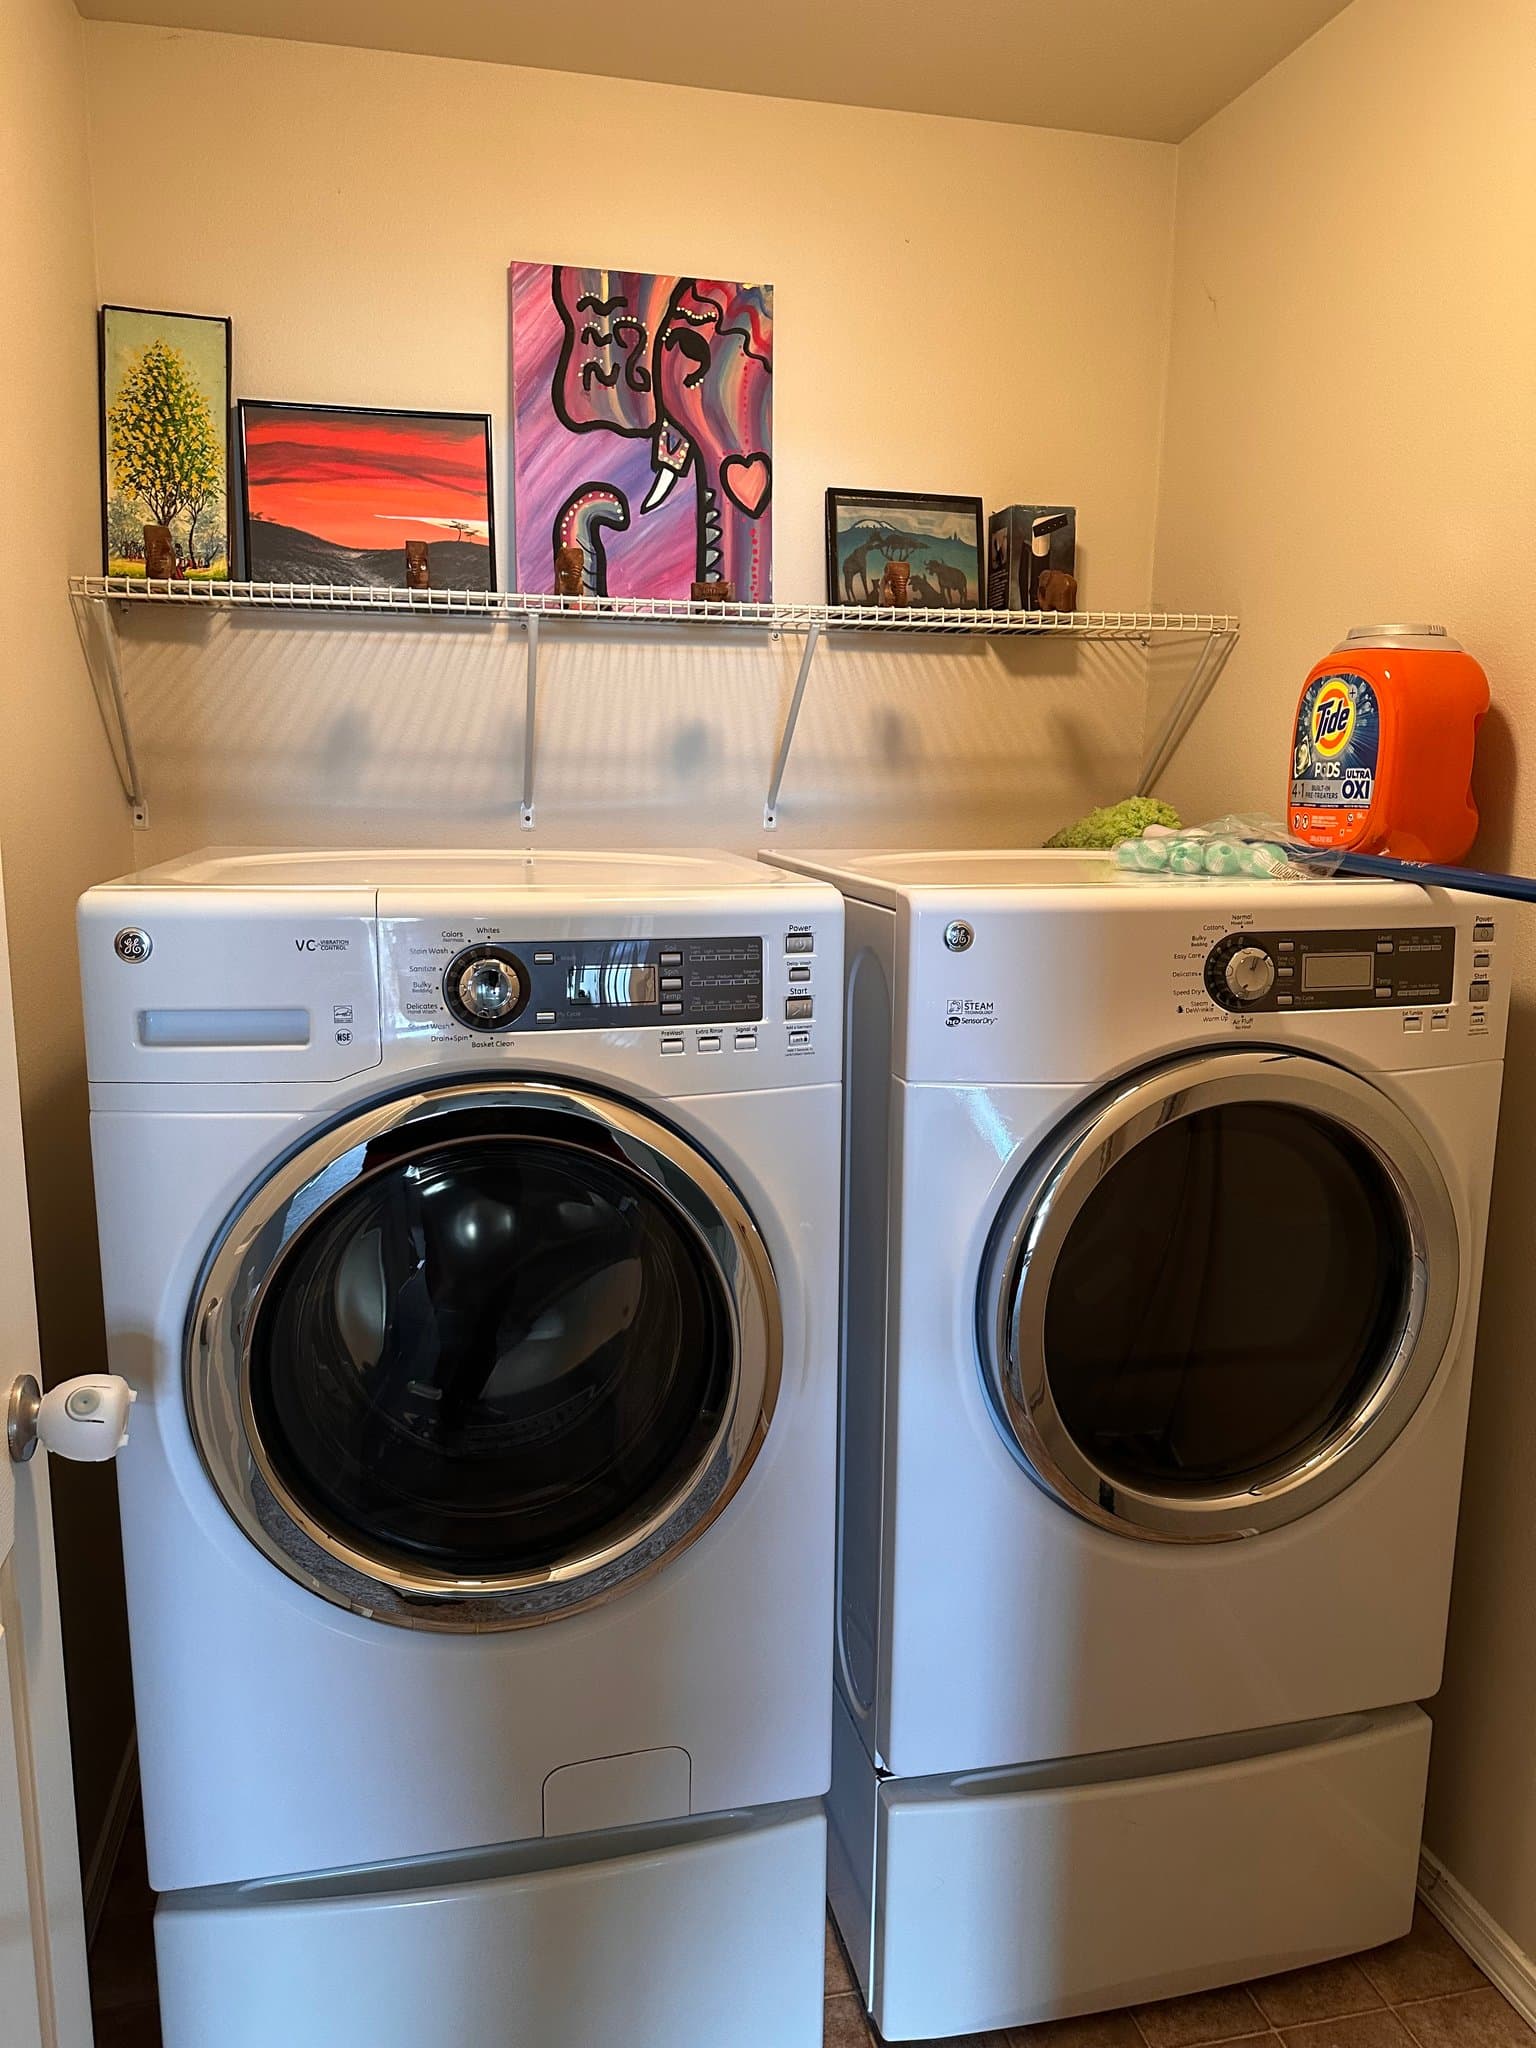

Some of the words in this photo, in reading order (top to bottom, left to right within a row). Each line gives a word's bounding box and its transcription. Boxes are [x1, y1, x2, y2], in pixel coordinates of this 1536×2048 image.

[1314, 697, 1350, 745] Tide
[1314, 761, 1341, 778] PODS
[1346, 768, 1371, 781] ULTRA
[1341, 780, 1371, 801] OXI
[1232, 913, 1253, 921] Normal
[1475, 915, 1493, 923] Power
[789, 924, 812, 932] Power
[1203, 924, 1225, 932] Cottons
[441, 930, 464, 938] Colors
[295, 939, 316, 951] VC
[663, 969, 680, 977] Spin
[413, 981, 432, 989] Bulky
[790, 987, 808, 995] Start
[663, 993, 682, 1001] Temp
[964, 1002, 994, 1011] STEAM
[471, 1040, 494, 1049] Basket
[495, 1039, 515, 1048] Clean
